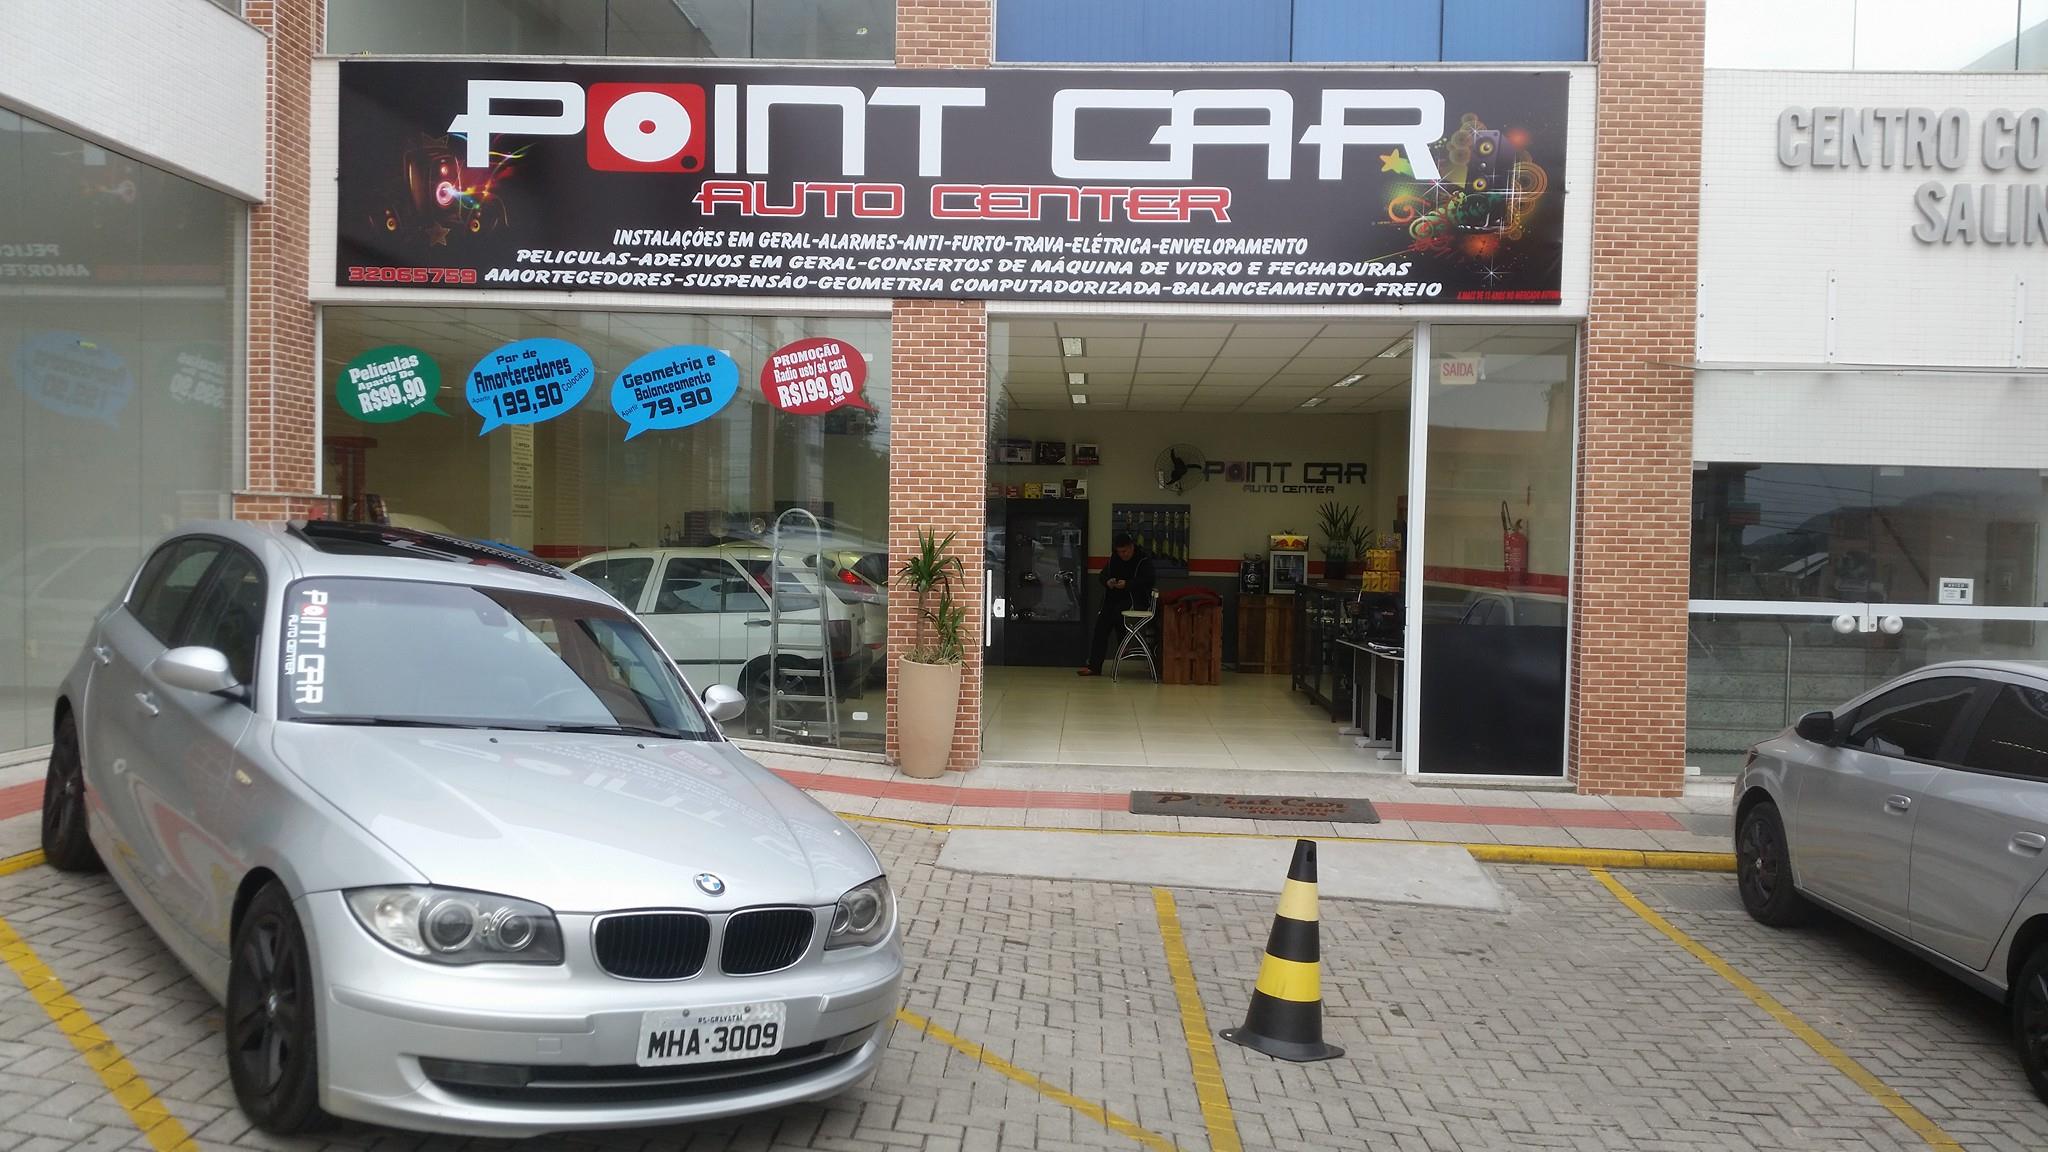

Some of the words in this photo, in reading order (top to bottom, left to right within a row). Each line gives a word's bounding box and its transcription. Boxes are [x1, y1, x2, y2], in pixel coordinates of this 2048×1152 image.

[447, 79, 986, 177] POINT
[1052, 88, 1446, 181] CAR
[1777, 105, 1970, 169] CENTRO
[692, 180, 905, 218] AUTO
[931, 182, 1232, 223] CENTER
[613, 227, 723, 250] INSTALAÇÕES
[728, 232, 753, 248] EM
[349, 266, 477, 283] 32065759
[750, 255, 782, 269] EM
[998, 258, 1027, 273] DE
[1030, 256, 1133, 275] MÁQUINA
[1140, 261, 1169, 275] DE
[1176, 260, 1243, 276] VIDRO
[1248, 261, 1263, 276] E
[1268, 261, 1412, 277] FECHADURAS
[348, 355, 419, 384] Peliculas
[496, 354, 518, 365] Par
[523, 350, 537, 359] de
[622, 357, 703, 389] Geometria
[707, 354, 716, 366] e
[773, 344, 840, 368] PROMOÇÃO
[773, 367, 798, 383] Radio
[828, 355, 847, 372] card
[474, 358, 572, 393] Amortecedores
[561, 367, 589, 392] Colocado
[634, 371, 712, 402] Balanceamento
[777, 370, 854, 408] R$199,90
[357, 376, 427, 414] R$99,90
[493, 381, 563, 418] 199,90
[642, 386, 713, 419] 79,90
[1203, 461, 1292, 484] POINT
[1303, 462, 1368, 484] CAR
[1243, 484, 1279, 493] AUTO
[1282, 485, 1335, 494] CENTER
[298, 590, 328, 649] POINT
[296, 654, 325, 704] CAR
